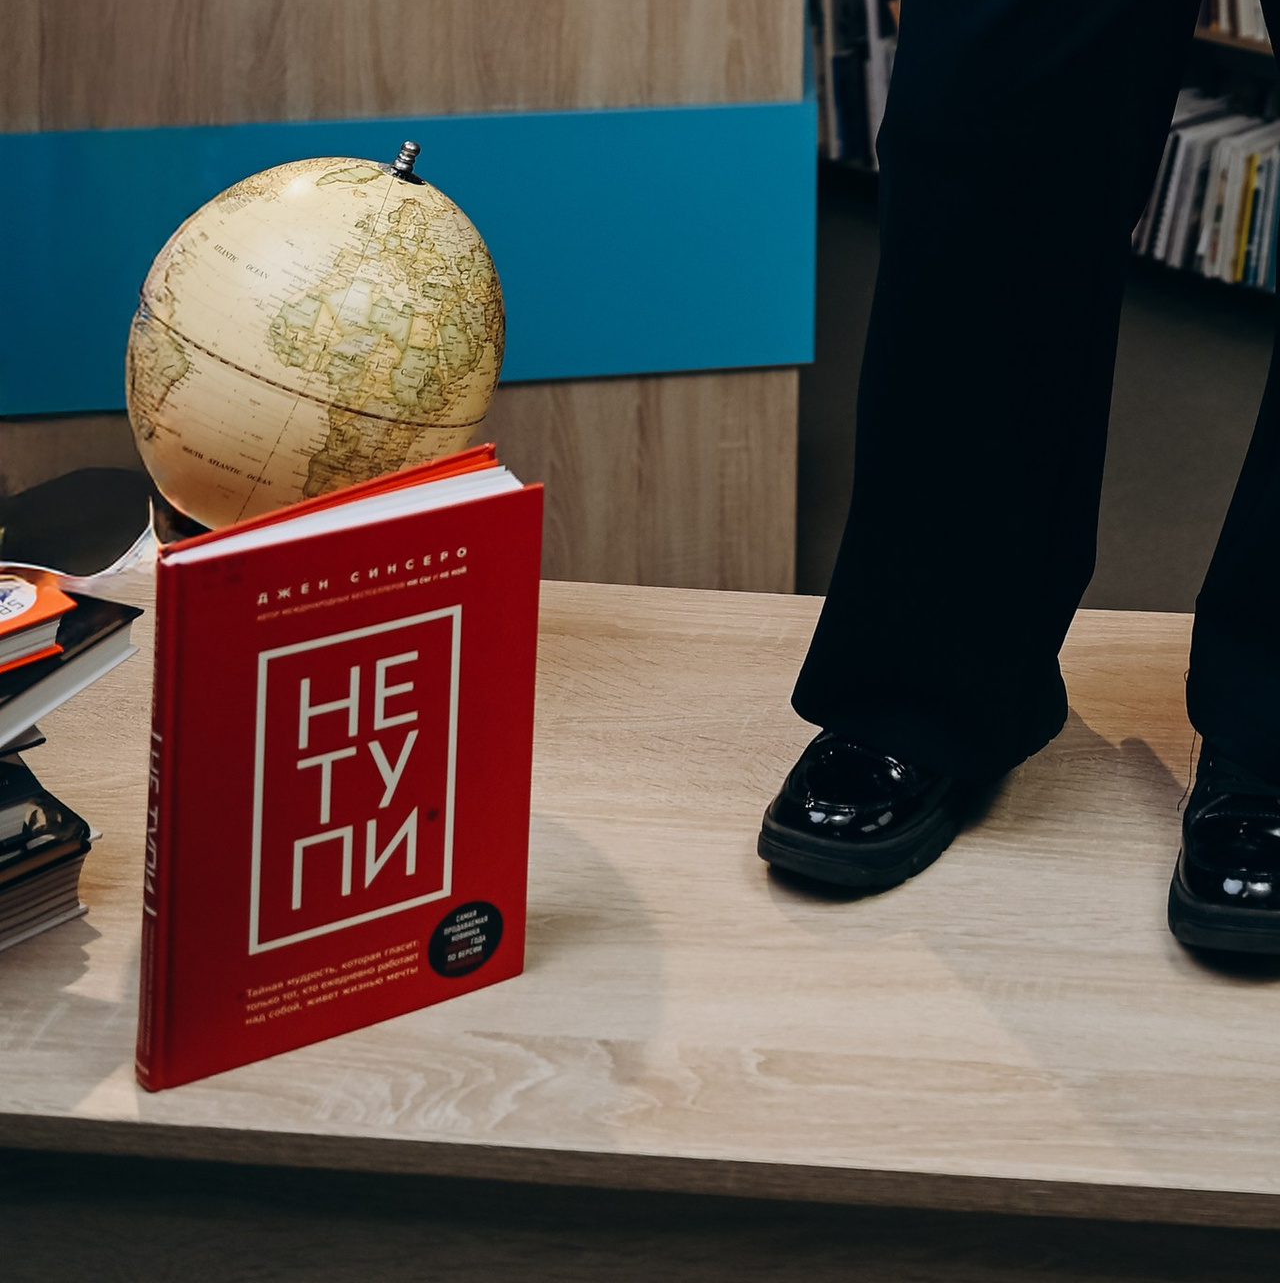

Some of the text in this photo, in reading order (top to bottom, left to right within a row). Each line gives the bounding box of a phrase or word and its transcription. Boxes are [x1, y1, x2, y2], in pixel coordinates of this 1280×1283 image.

[256, 546, 468, 607] ДЖЕН СИНСЕРО
[298, 650, 419, 750] НЕ
[296, 728, 419, 825] ТУ
[291, 805, 418, 911] ПИ
[302, 982, 319, 996] кто
[377, 951, 420, 974] работает
[341, 951, 382, 971] которая
